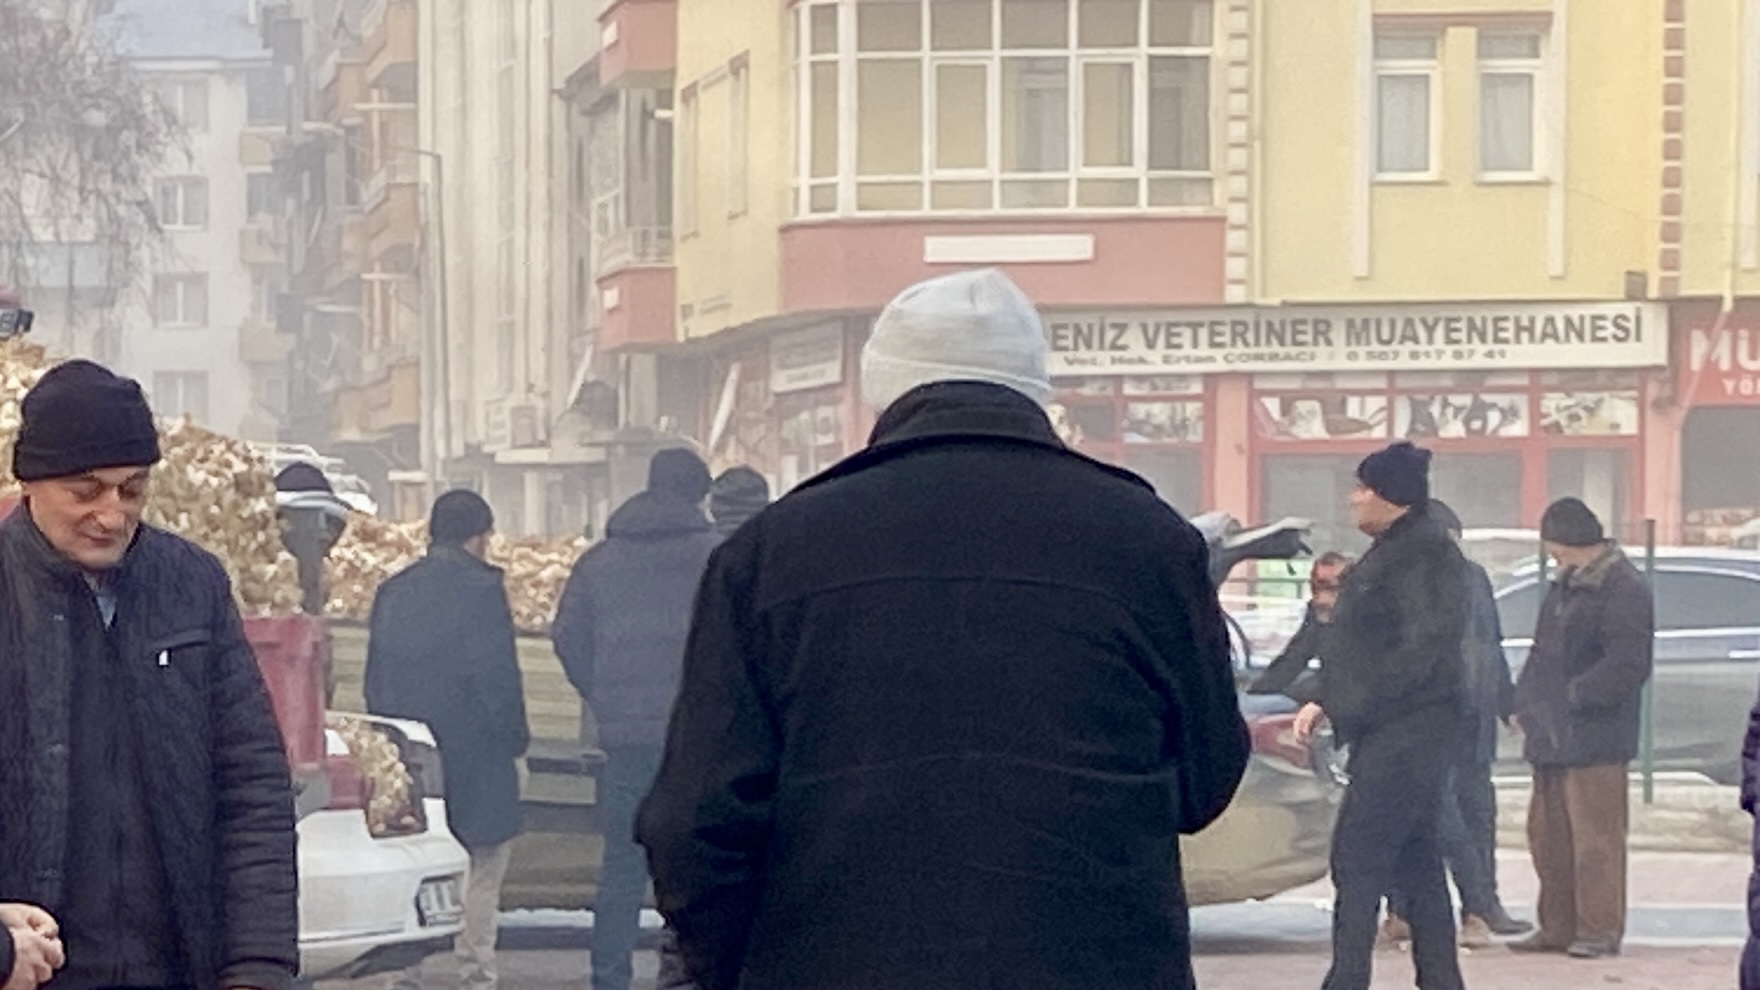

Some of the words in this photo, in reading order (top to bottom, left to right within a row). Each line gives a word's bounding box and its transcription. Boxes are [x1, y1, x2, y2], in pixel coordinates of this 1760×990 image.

[1051, 316, 1130, 351] ENİZ
[1139, 311, 1333, 350] VETERİNER
[1345, 306, 1642, 347] MUAYENEHANESİ
[1161, 353, 1217, 366] Ertan
